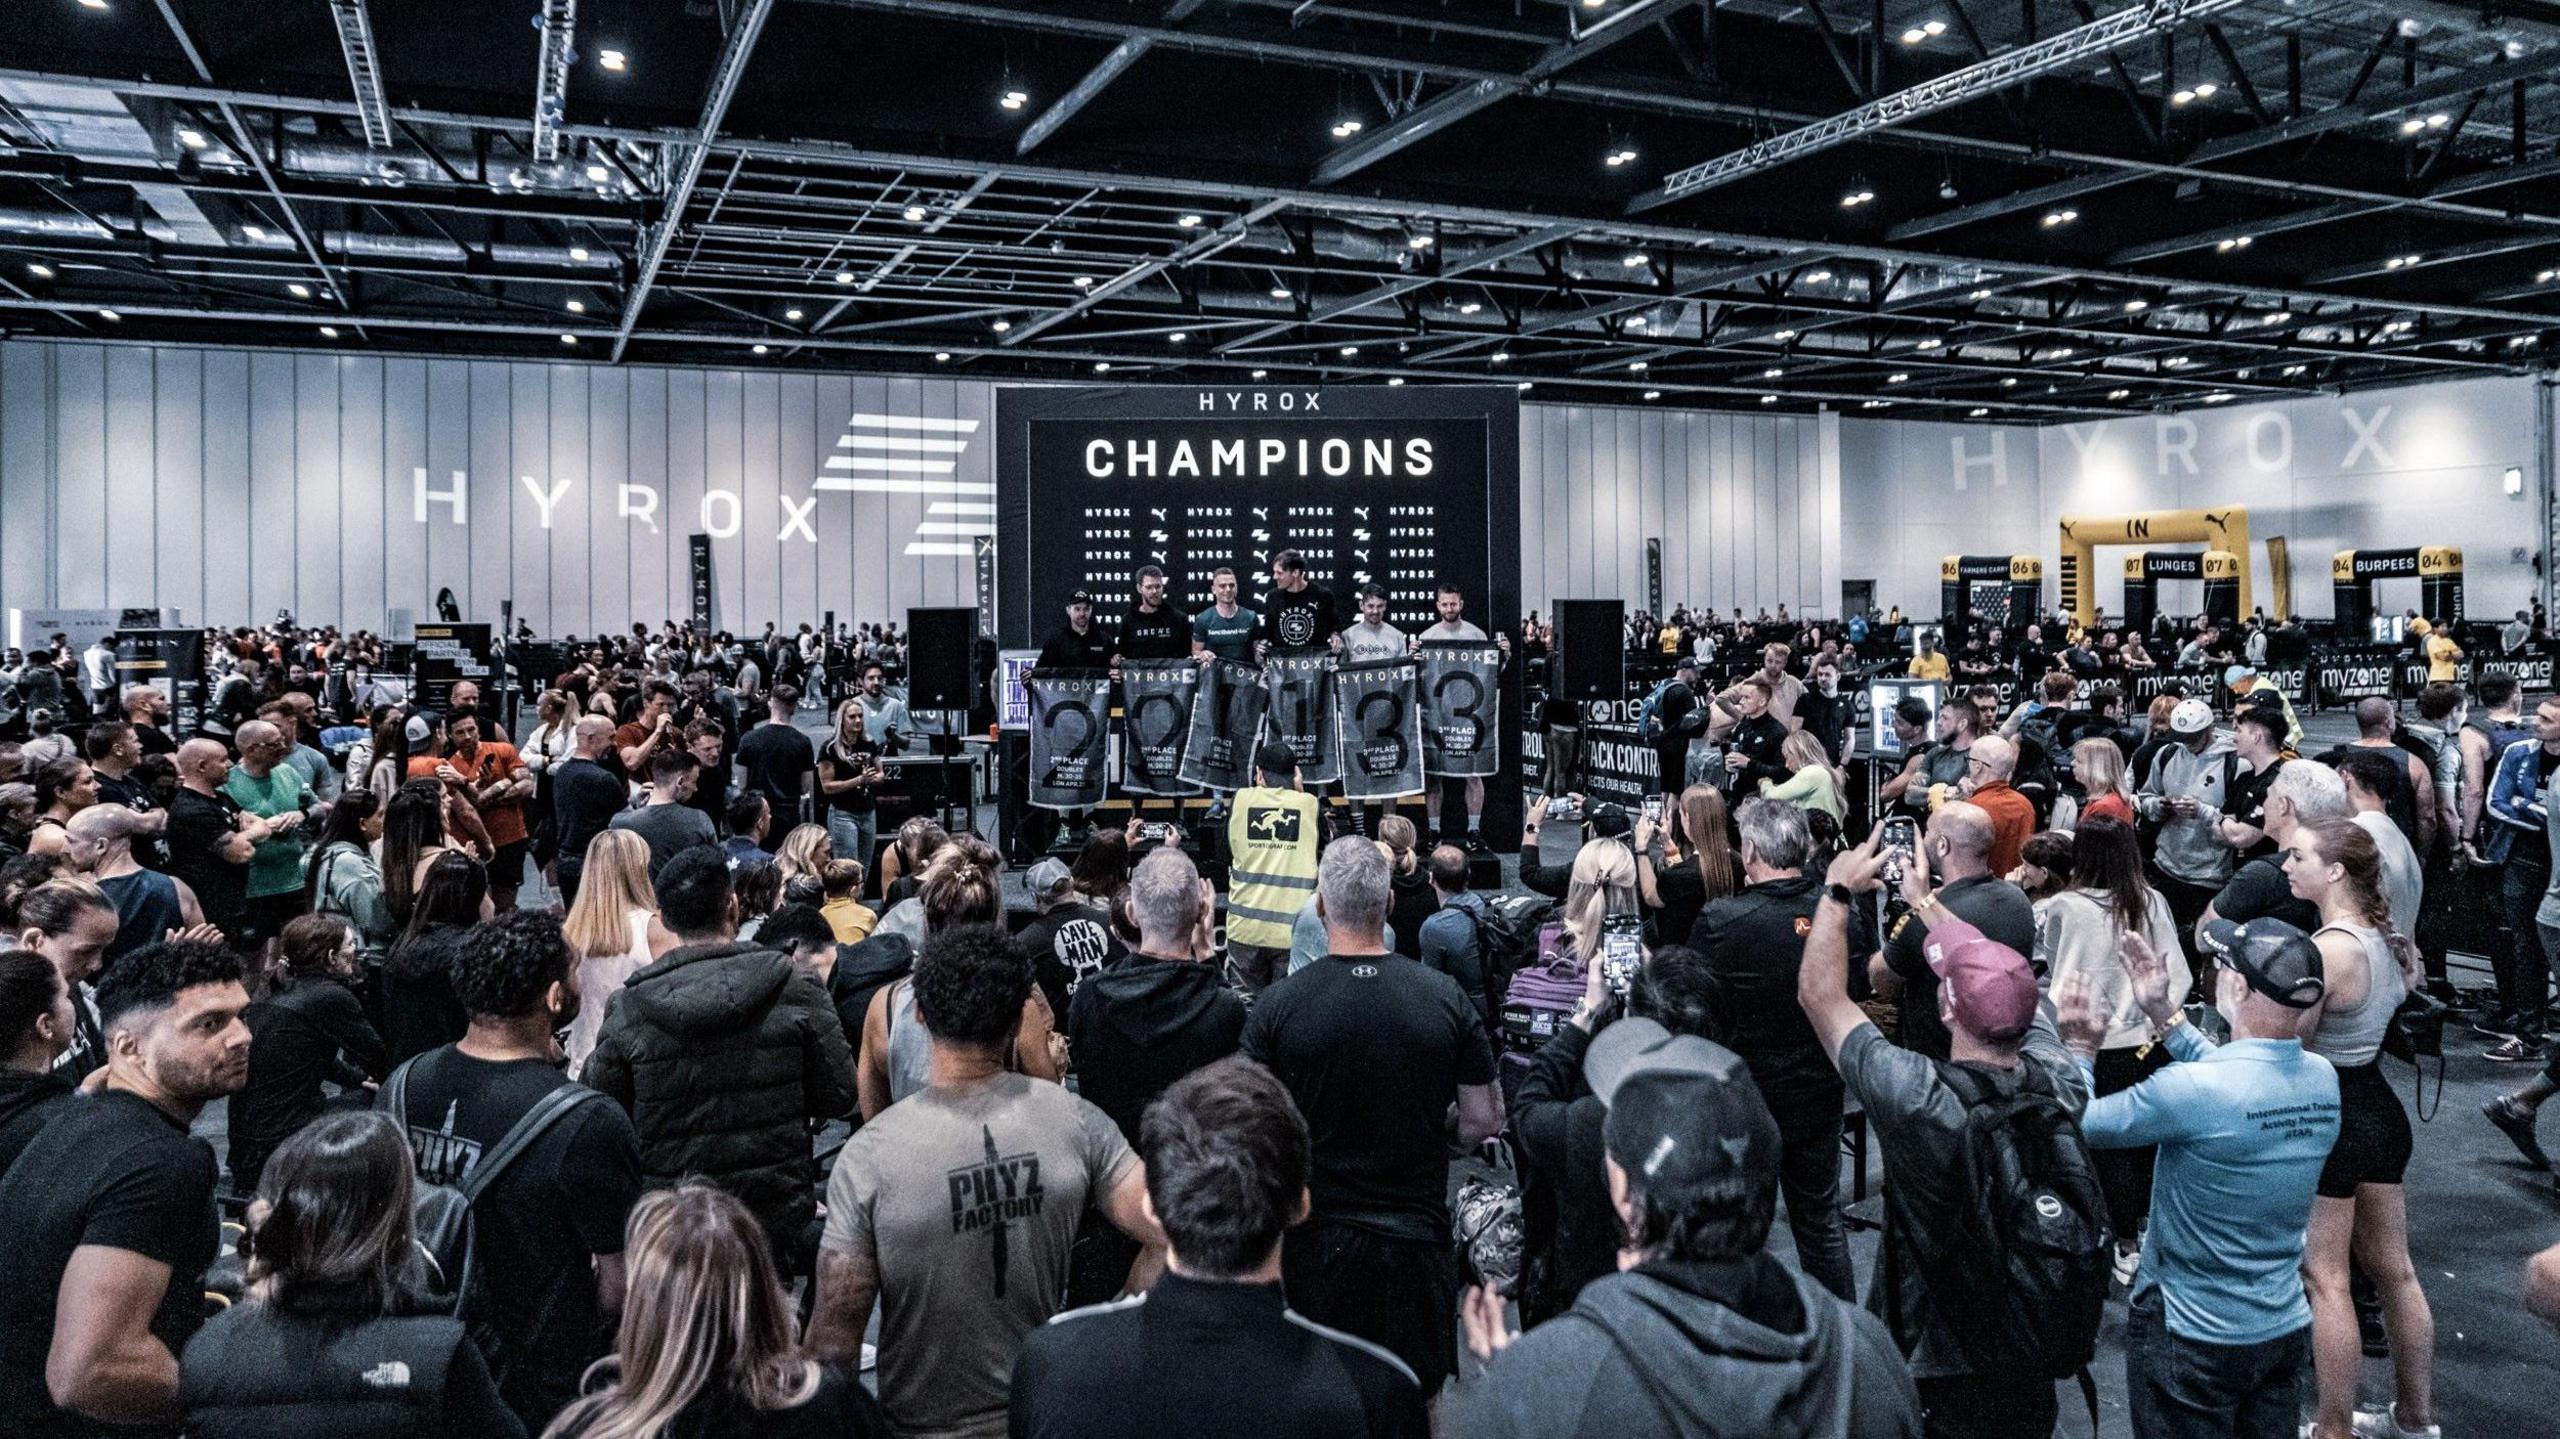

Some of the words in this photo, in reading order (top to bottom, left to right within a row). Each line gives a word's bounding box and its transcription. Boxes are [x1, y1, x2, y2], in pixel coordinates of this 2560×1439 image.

[1200, 392, 1321, 412] HYROX
[1952, 404, 2396, 491] HYROX
[1085, 438, 1434, 478] CHAMPIONS
[413, 467, 819, 543] HYROX
[1390, 506, 1434, 515] HYROX
[1085, 508, 1131, 517] HYROX
[1187, 507, 1232, 516] HYROX
[1289, 507, 1333, 516] HYROX
[1187, 529, 1232, 538] HYROX
[1289, 528, 1333, 537] HYROX
[1390, 528, 1434, 537] HYROX
[2127, 519, 2148, 538] IN
[1085, 530, 1131, 539] HYROX
[1085, 551, 1131, 560] HYROX
[1187, 550, 1232, 559] HYROX
[1299, 550, 1334, 559] YROX
[1390, 549, 1434, 558] HYROX
[2126, 559, 2140, 572] 07
[2149, 560, 2196, 572] LUNGES
[2206, 560, 2223, 573] 07
[2229, 558, 2237, 571] 0
[2333, 559, 2349, 572] 04
[2356, 557, 2415, 572] BURPEES
[2422, 554, 2442, 568] 04
[1942, 563, 1956, 575] 06
[2013, 561, 2028, 574] 06
[2032, 562, 2041, 573] 0
[1085, 572, 1131, 581] HYROX
[1187, 572, 1213, 581] HYR
[1308, 571, 1334, 580] ROX
[1390, 570, 1434, 579] HYROX
[694, 546, 707, 621] HYROX
[1090, 594, 1131, 603] YROX
[1187, 593, 1213, 601] HYR
[1390, 592, 1434, 600] HYROX
[1280, 606, 1313, 619] HYROX
[1390, 613, 1434, 621] HYROX
[1096, 615, 1122, 624] YRO
[1267, 658, 1322, 670] HYROX
[1224, 664, 1258, 682] ROX
[1338, 670, 1399, 685] HYROX
[1033, 681, 1092, 692] HYROX
[2322, 667, 2390, 696] myzone
[1451, 727, 1476, 735] PLACE
[1152, 746, 1176, 754] PLACE
[1375, 744, 1400, 753] PLACE
[1063, 757, 1088, 765] PLACE
[1370, 754, 1396, 762] DOUBLES
[1617, 744, 1661, 777] CONTR
[1606, 778, 1619, 791] OUR
[1061, 922, 1098, 945] CAVE
[1065, 937, 1104, 968] MAN
[2246, 1104, 2311, 1120] International
[2261, 1118, 2297, 1131] Activity
[949, 1158, 1044, 1212] PHYZ
[952, 1195, 1044, 1234] FACTORY
